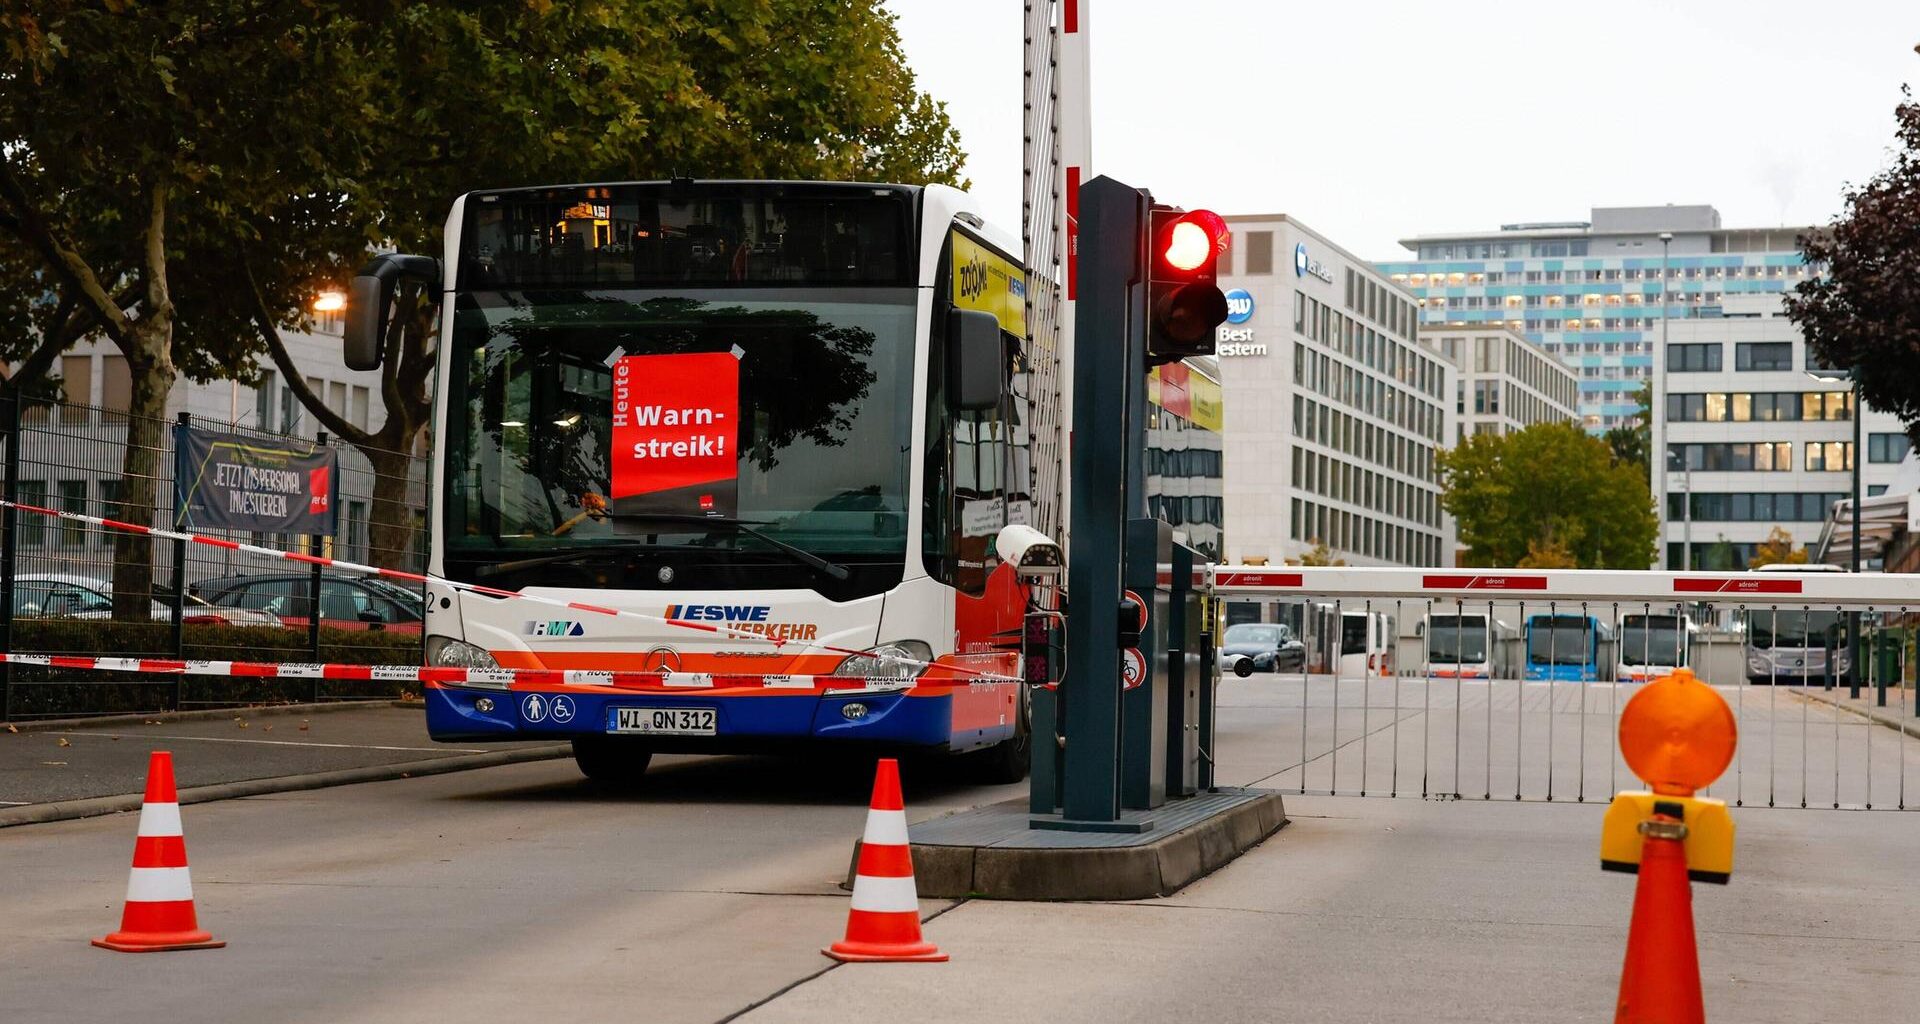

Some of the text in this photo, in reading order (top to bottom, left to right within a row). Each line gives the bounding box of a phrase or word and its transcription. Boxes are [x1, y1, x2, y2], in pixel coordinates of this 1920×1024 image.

[1219, 327, 1253, 341] Best
[1216, 342, 1267, 356] estern
[613, 358, 629, 427] Heute:
[635, 405, 724, 427] Warn-
[633, 435, 725, 459] streik!
[213, 463, 242, 488] JETZT
[259, 468, 302, 495] PERSONAL
[229, 490, 287, 517] INVESTIEREN!
[684, 605, 770, 621] ESWE
[727, 623, 818, 640] VERKEHR
[619, 710, 713, 730] WI QN 312
